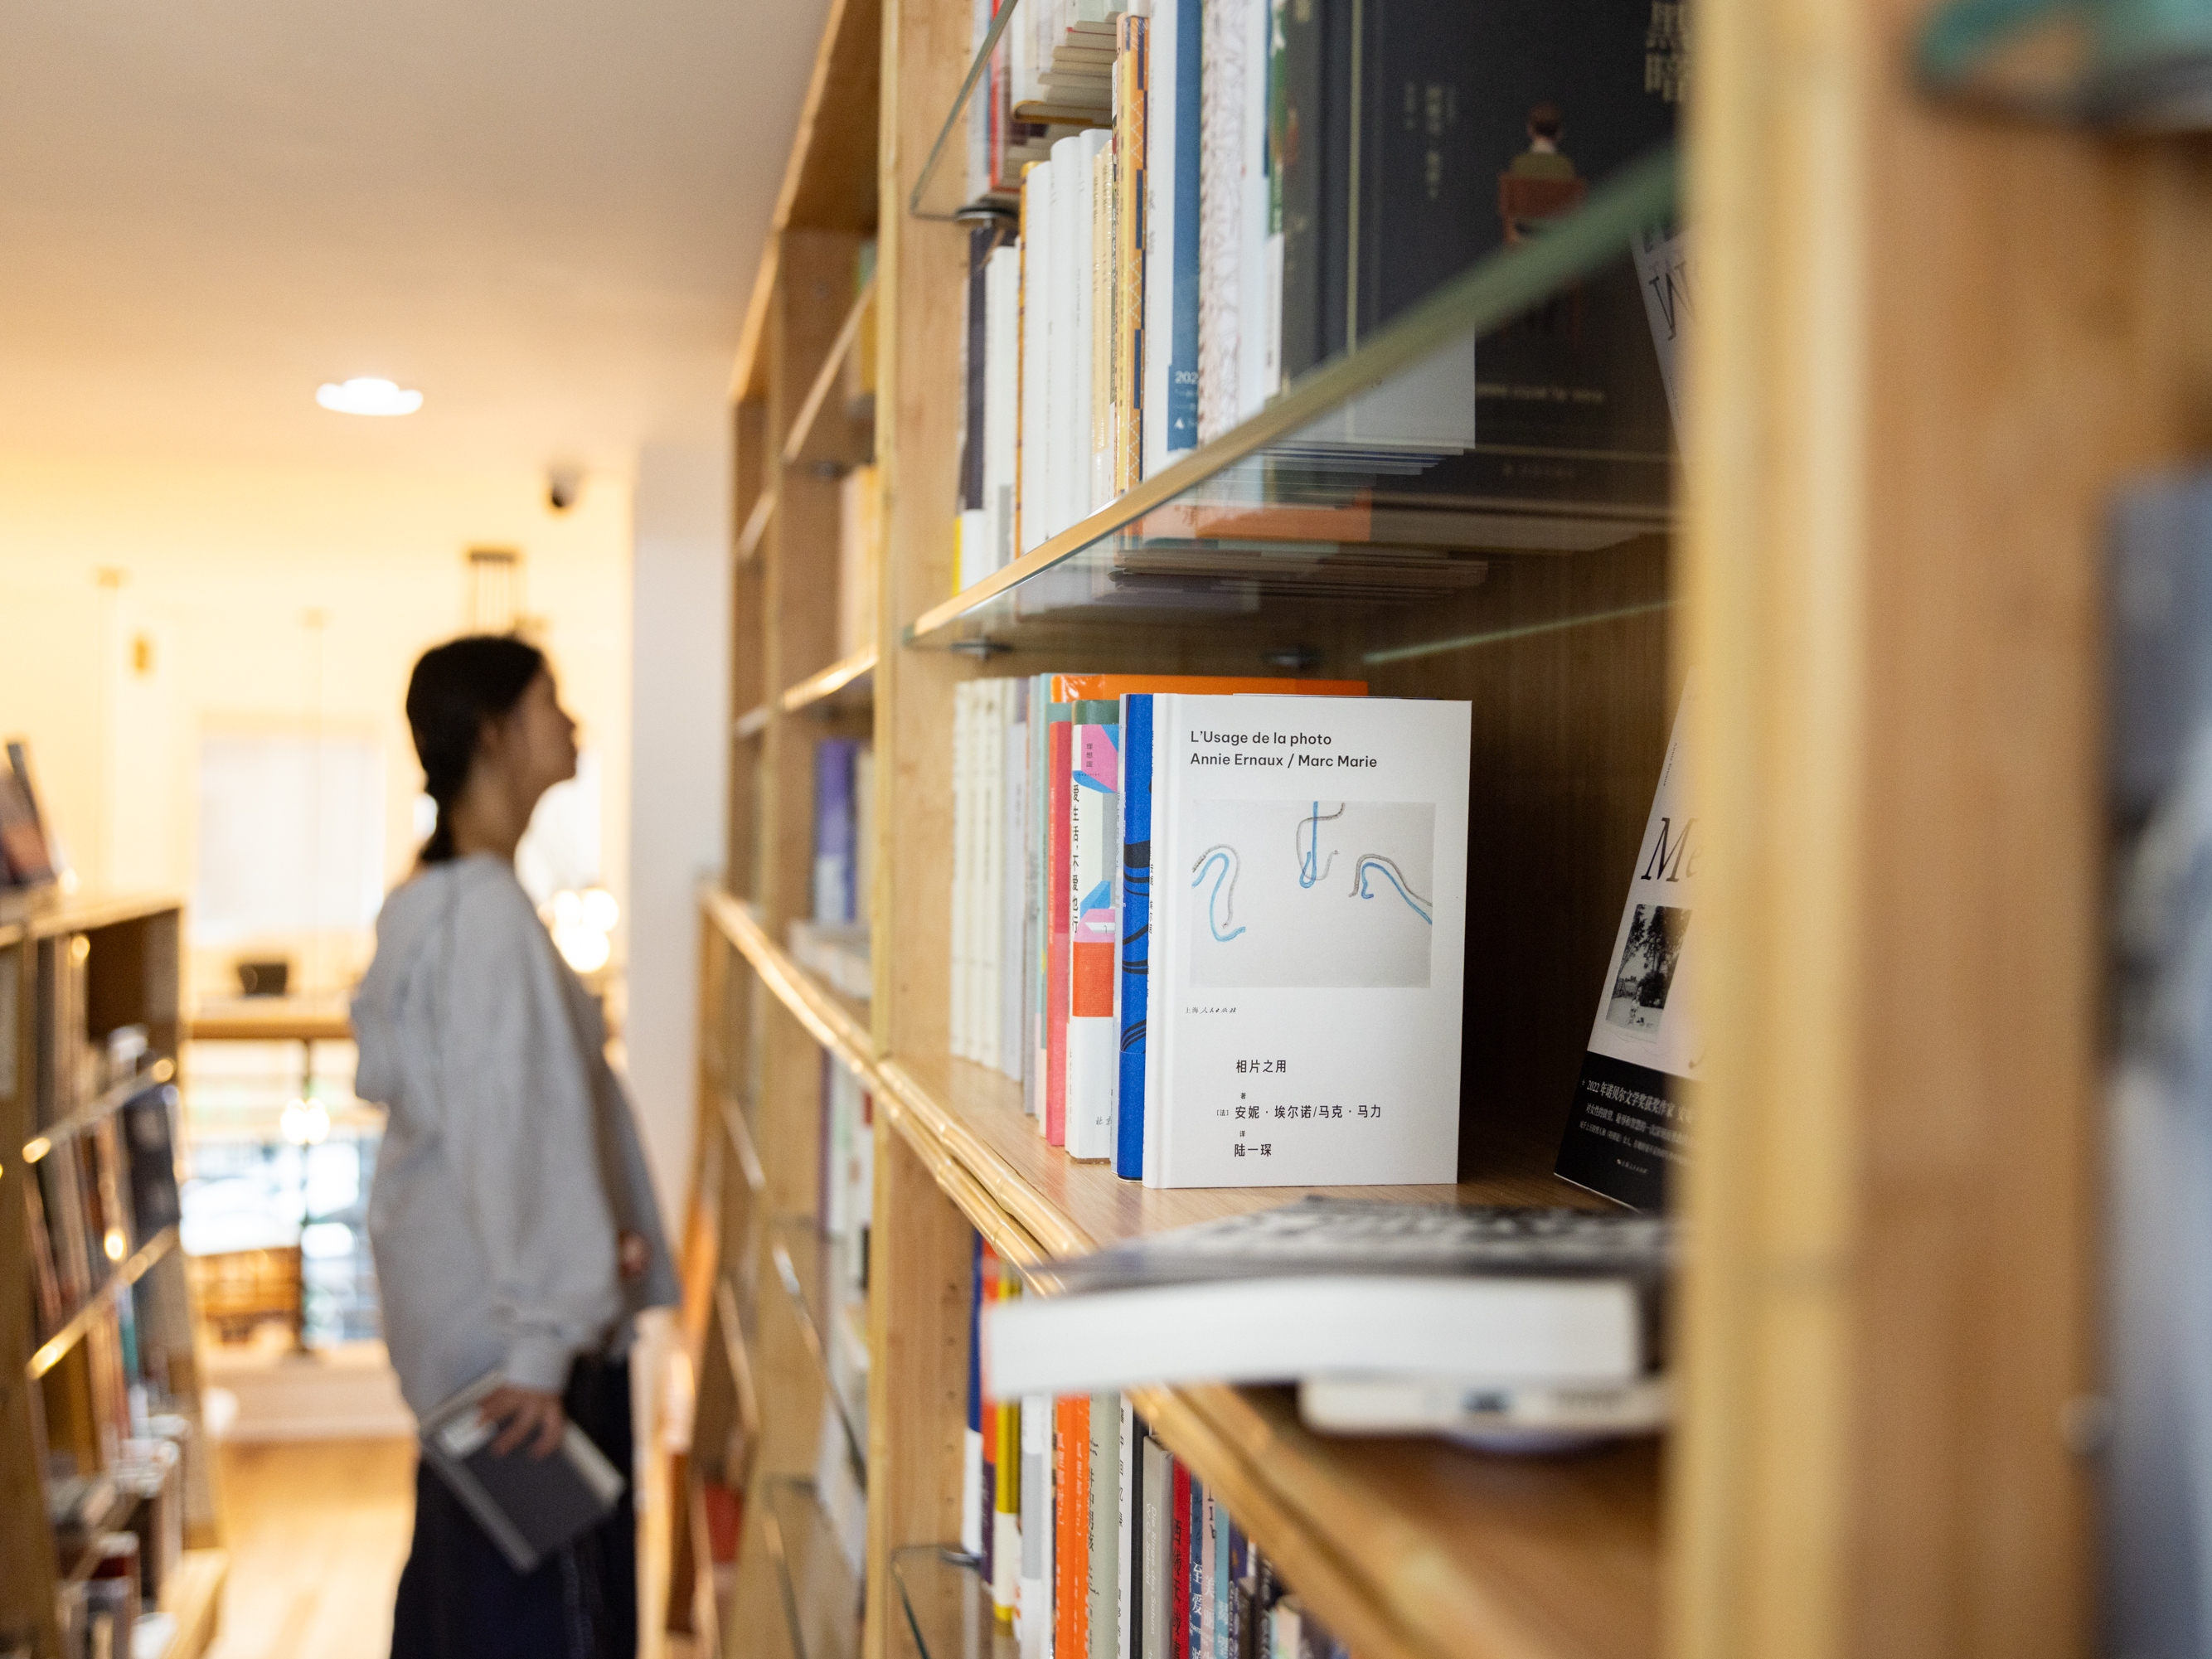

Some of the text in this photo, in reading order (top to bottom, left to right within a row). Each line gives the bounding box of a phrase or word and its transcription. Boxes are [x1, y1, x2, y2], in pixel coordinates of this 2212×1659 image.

[1252, 731, 1269, 744] de
[1273, 732, 1286, 744] la
[1290, 733, 1332, 747] photo
[1191, 753, 1377, 769] Annie Ernaux / Marc Marie
[1235, 1060, 1286, 1073] 相片之用
[1234, 1143, 1272, 1157] 陆一琛
